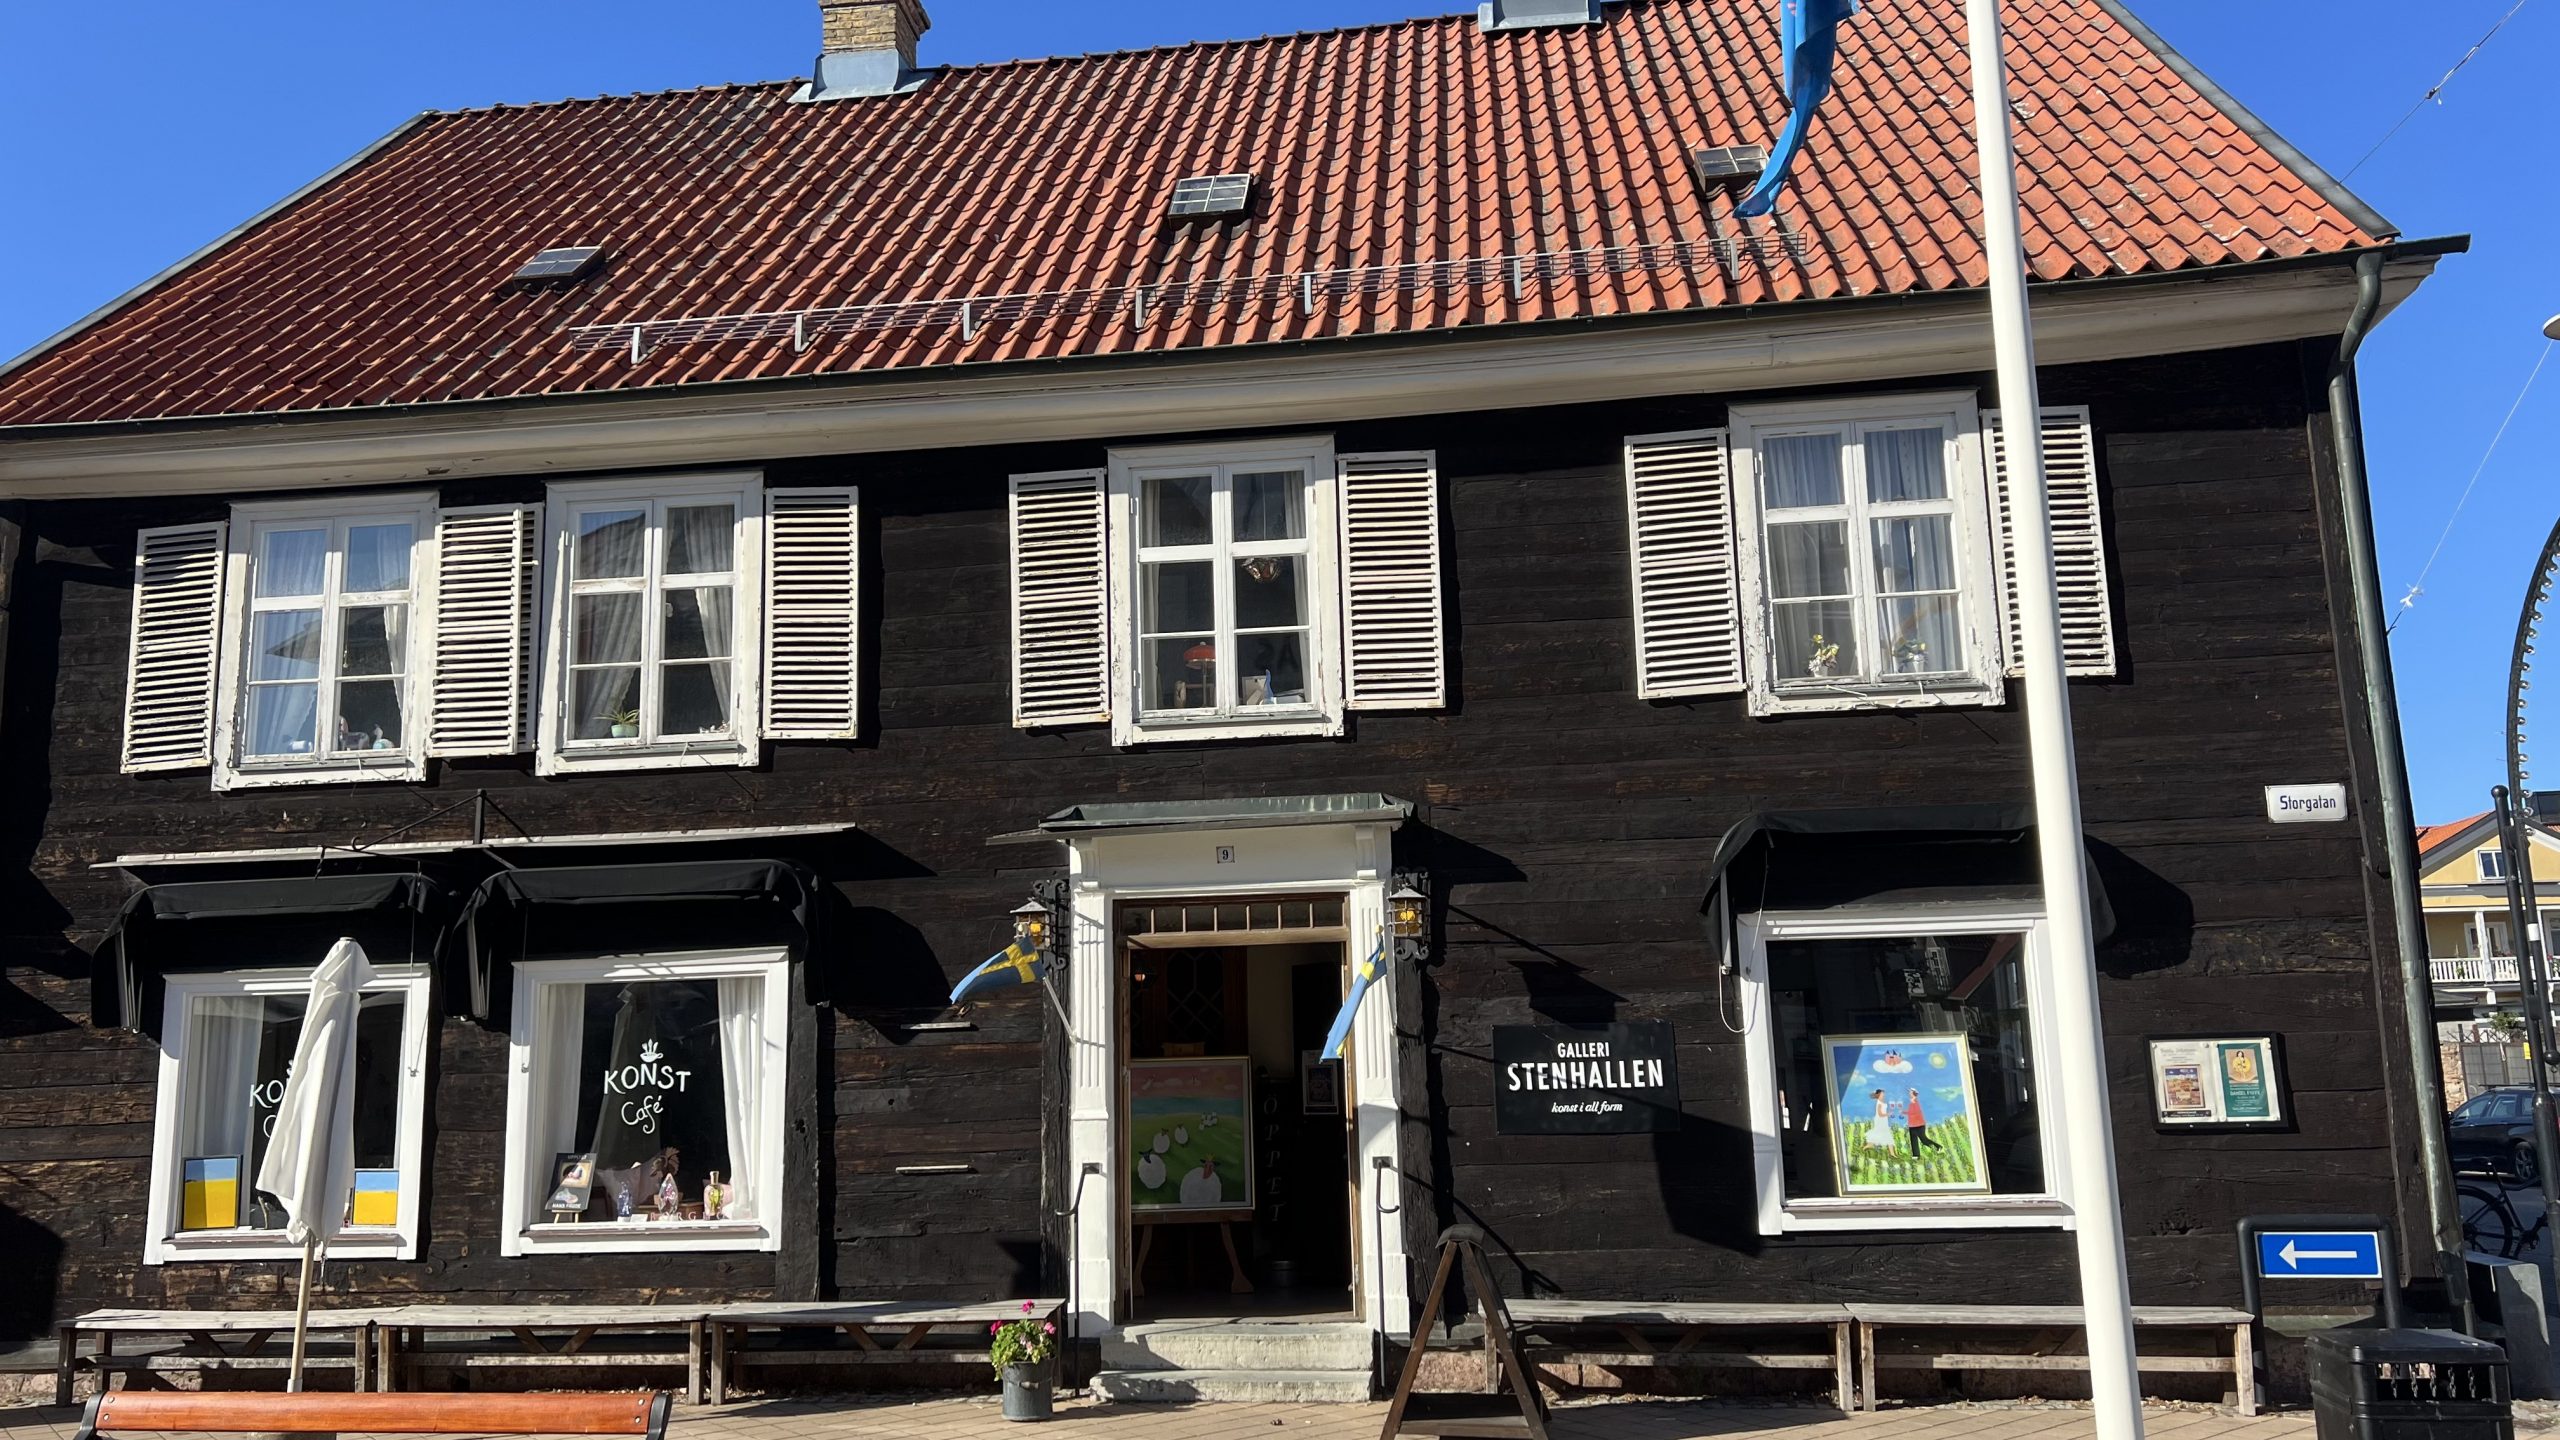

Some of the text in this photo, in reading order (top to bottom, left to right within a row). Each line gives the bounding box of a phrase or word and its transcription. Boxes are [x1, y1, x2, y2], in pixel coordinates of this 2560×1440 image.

[2280, 795, 2336, 812] Storgatan
[1222, 849, 1229, 861] 9
[1557, 1042, 1610, 1058] GALLERI
[604, 1063, 691, 1094] KONST
[1507, 1059, 1664, 1091] STENHALLEN
[621, 1095, 664, 1134] Café
[1551, 1102, 1577, 1113] konst
[1585, 1101, 1599, 1112] all
[1598, 1101, 1623, 1114] form
